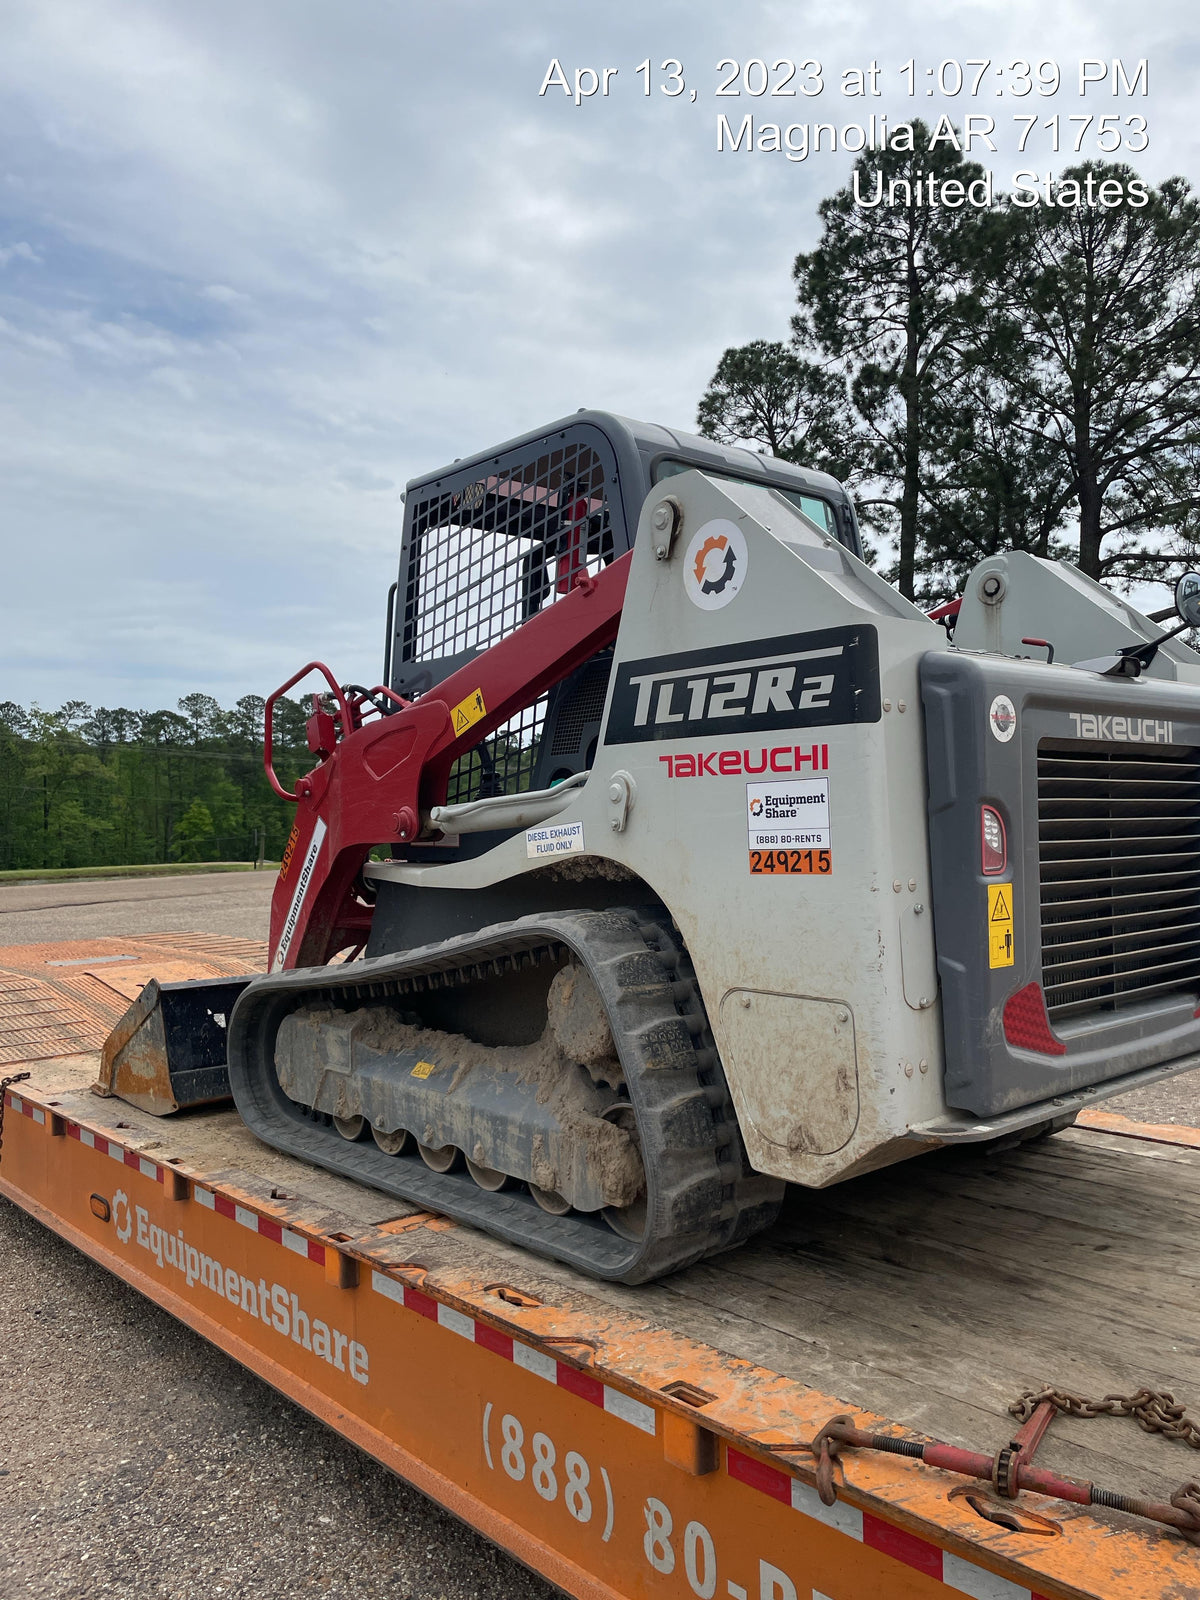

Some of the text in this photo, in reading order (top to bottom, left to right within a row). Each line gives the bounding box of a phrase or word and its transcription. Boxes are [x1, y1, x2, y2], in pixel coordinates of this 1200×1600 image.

[765, 793, 825, 807] Equipment
[765, 808, 797, 819] Share
[527, 825, 581, 842] DIESEL EXHAUST
[756, 834, 822, 844] (888) 80-RENTS
[280, 826, 299, 880] 249215
[536, 840, 573, 853] FLUID ONLY
[751, 850, 830, 873] 249215
[281, 844, 318, 951] EquipmentShare
[135, 1204, 369, 1386] EquipmentShare
[482, 1402, 614, 1542] (888)
